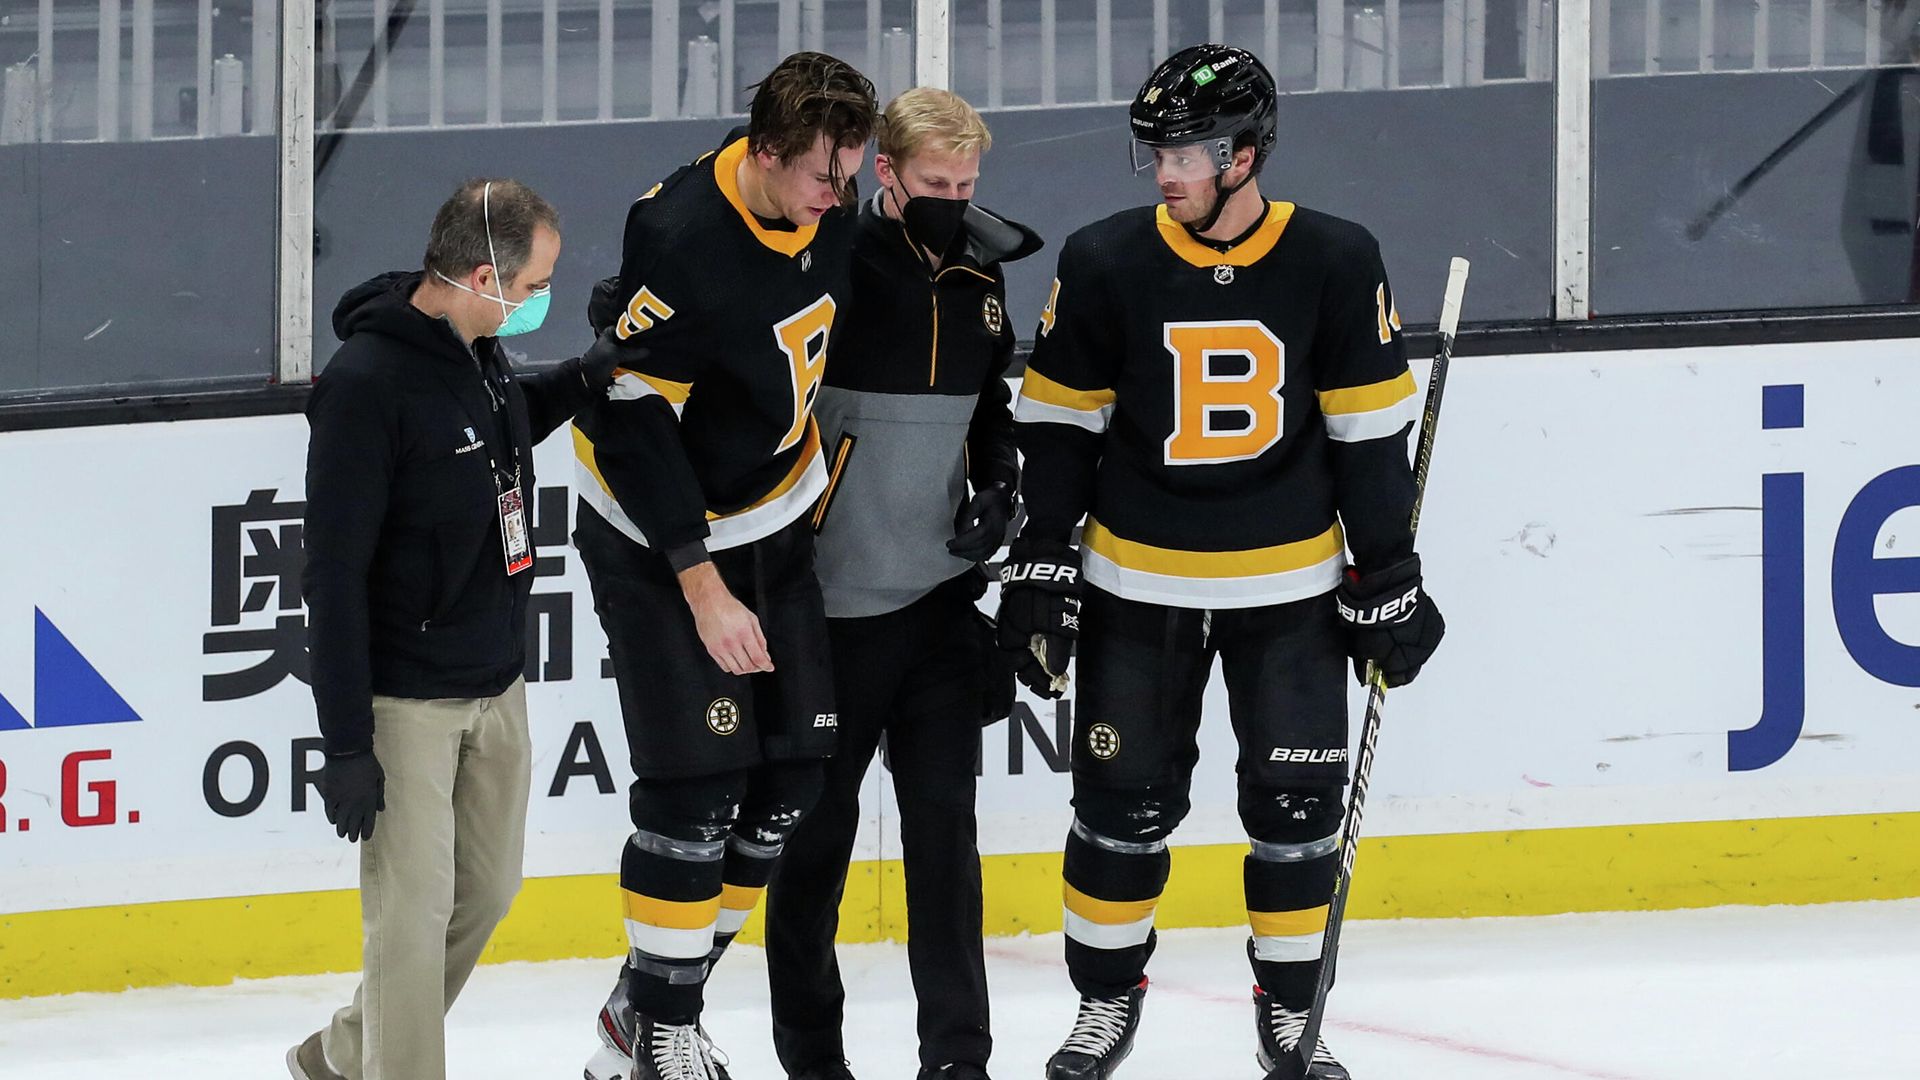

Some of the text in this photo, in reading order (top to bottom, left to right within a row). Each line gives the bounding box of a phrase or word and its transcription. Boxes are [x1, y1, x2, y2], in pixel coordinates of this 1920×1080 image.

[1211, 55, 1239, 73] Bank
[1143, 86, 1163, 104] 14
[1163, 319, 1286, 467] B
[999, 562, 1078, 584] AUER
[1336, 586, 1418, 625] AUER
[0, 749, 140, 833] .G.
[202, 738, 327, 818] OR
